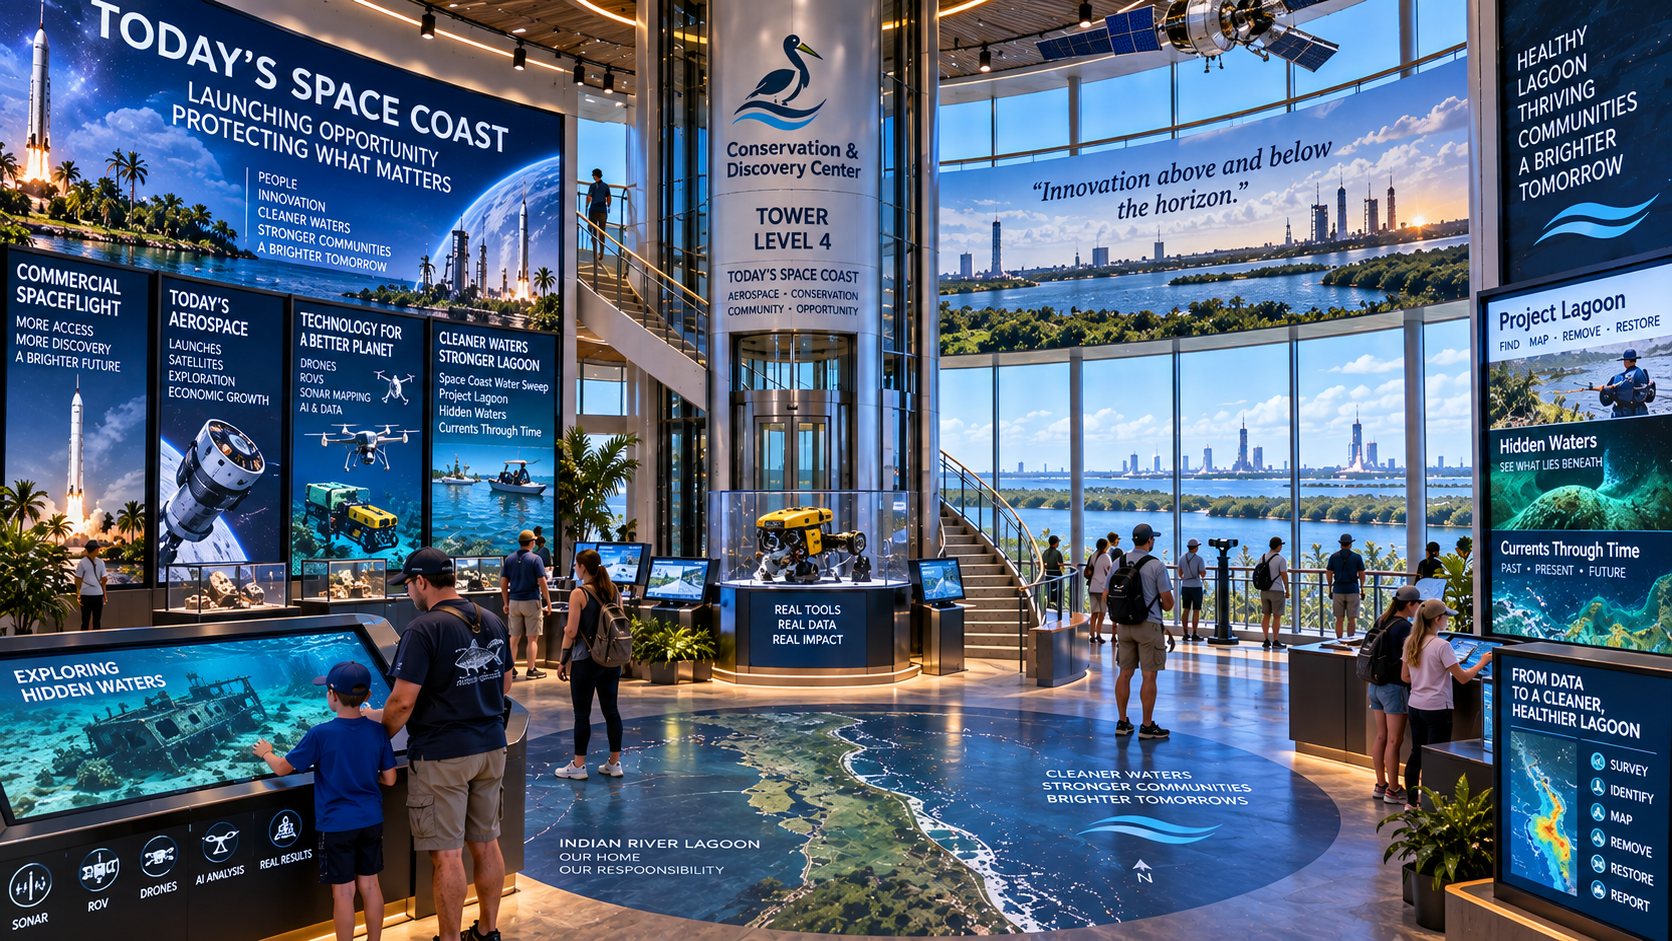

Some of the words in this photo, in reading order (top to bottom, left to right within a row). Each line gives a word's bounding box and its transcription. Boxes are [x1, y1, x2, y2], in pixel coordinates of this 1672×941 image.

[1518, 25, 1587, 71] HEALTHY
[1518, 53, 1586, 97] LAGOON
[291, 68, 399, 127] SPACE
[411, 105, 509, 152] COAST
[1517, 79, 1595, 122] THRIVING
[187, 81, 312, 136] LAUNCHING
[320, 121, 438, 169] OPPORTUNITY
[1517, 90, 1637, 148] COMMUNITIES
[173, 104, 308, 158] PROTECTING
[315, 143, 371, 174] WHAT
[377, 159, 451, 193] MATTERS
[727, 139, 841, 157] Conservation
[846, 142, 858, 159] &
[1519, 157, 1530, 176] A
[1535, 128, 1616, 170] BRIGHTER
[727, 161, 806, 179] Discovery
[811, 160, 861, 179] Center
[1157, 162, 1216, 185] above
[1222, 147, 1263, 175] and
[1270, 140, 1332, 167] below
[259, 171, 297, 190] PEOPLE
[1519, 154, 1623, 201] TOMORROW
[259, 189, 325, 212] INNOVATION
[1118, 198, 1149, 220] the
[258, 206, 307, 226] CLEANER
[310, 216, 351, 234] WATERS
[756, 207, 828, 225] TOWER
[258, 224, 316, 245] STRONGER
[319, 235, 391, 257] COMMUNITIES
[755, 232, 813, 250] LEVEL
[819, 233, 831, 250] 4
[257, 241, 266, 253] A
[269, 243, 322, 263] BRIGHTER
[325, 252, 387, 272] TOMORROW
[17, 263, 121, 295] COMMERCIAL
[780, 268, 817, 281] SPACE
[820, 269, 859, 283] COAST
[17, 286, 121, 316] SPACEFLIGHT
[728, 289, 779, 301] AEROSPACE
[791, 289, 858, 301] CONSERVATION
[728, 304, 784, 316] COMMUNITY
[796, 304, 859, 316] OPPORTUNITY
[1500, 304, 1557, 332] Project
[1562, 294, 1625, 321] Lagoon
[16, 315, 49, 331] MORE
[52, 321, 94, 337] ACCESS
[169, 311, 248, 336] AEROSPACE
[300, 312, 378, 336] TECHNOLOGY
[381, 324, 402, 340] FOR
[1500, 339, 1520, 351] FIND
[1529, 334, 1549, 347] MAP
[1563, 325, 1601, 342] REMOVE
[1616, 315, 1660, 333] RESTORE
[16, 333, 49, 348] MORE
[52, 337, 111, 355] DISCOVERY
[169, 338, 222, 355] LAUNCHES
[300, 332, 308, 346] A
[310, 333, 349, 352] BETTER
[353, 339, 394, 357] PLANET
[439, 331, 486, 349] CLEANER
[489, 337, 528, 353] WATERS
[15, 350, 24, 363] A
[27, 352, 79, 368] BRIGHTER
[82, 358, 121, 372] FUTURE
[169, 354, 223, 371] SATELLITES
[300, 358, 336, 372] DRONES
[439, 349, 495, 367] STRONGER
[498, 356, 540, 371] LAGOON
[169, 370, 235, 387] EXPLORATION
[300, 372, 324, 384] ROVS
[439, 372, 466, 386] Space
[468, 375, 492, 387] Coast
[494, 377, 520, 389] Water
[522, 379, 549, 394] Sweep
[169, 386, 224, 401] ECONOMIC
[226, 391, 269, 406] GROWTH
[300, 387, 330, 399] SONAR
[333, 390, 371, 402] MAPPING
[439, 388, 471, 403] Project
[474, 391, 508, 406] Lagoon
[299, 402, 309, 412] AI
[311, 403, 318, 413] &
[321, 404, 343, 415] DATA
[439, 405, 472, 418] Hidden
[474, 407, 507, 420] Waters
[439, 421, 479, 434] Currents
[480, 423, 518, 439] Through
[520, 426, 542, 437] Time
[1500, 437, 1545, 454] Hidden
[1549, 434, 1597, 451] Waters
[1500, 461, 1514, 472] SEE
[1516, 460, 1540, 471] WHAT
[1542, 459, 1560, 470] LIES
[1562, 457, 1603, 469] BENEATH
[1501, 540, 1550, 556] Currents
[1552, 541, 1603, 561] Through
[1606, 542, 1640, 558] Time
[1501, 563, 1522, 574] PAST
[1535, 564, 1574, 576] PRESENT
[1589, 566, 1626, 578] FUTURE
[775, 604, 802, 615] REAL
[805, 605, 841, 615] TOOLS
[778, 619, 805, 630] REAL
[809, 619, 837, 630] DATA
[773, 634, 800, 645] REAL
[803, 634, 843, 645] IMPACT
[14, 661, 119, 684] EXPLORING
[1513, 668, 1547, 686] FROM
[1551, 673, 1584, 691] DATA
[21, 682, 94, 702] HIDDEN
[96, 674, 166, 693] WATERS
[1512, 685, 1528, 700] TO
[1531, 688, 1540, 702] A
[1543, 690, 1605, 715] CLEANER,
[1513, 703, 1576, 727] HEALTHIER
[1581, 714, 1640, 739] LAGOON
[1046, 770, 1121, 779] CLEANER
[1125, 771, 1192, 779] WATERS
[1610, 759, 1648, 777] SURVEY
[1042, 782, 1131, 791] STRONGER
[1136, 783, 1252, 792] COMMUNITIES
[1610, 785, 1654, 804] IDENTIFY
[1047, 795, 1131, 804] BRIGHTER
[1135, 795, 1248, 805] TOMORROWS
[1611, 810, 1633, 825] MAP
[560, 839, 621, 848] INDIAN
[628, 839, 678, 848] RIVER
[685, 839, 760, 849] LAGOON
[1611, 836, 1652, 858] REMOVE
[260, 857, 280, 869] REAL
[281, 849, 312, 865] RESULTS
[559, 853, 591, 861] OUR
[597, 853, 640, 862] HOME
[196, 874, 204, 885] AI
[206, 865, 245, 883] ANALYSIS
[559, 865, 591, 874] OUR
[1137, 873, 1153, 883] N
[1611, 862, 1654, 886] RESTORE
[140, 881, 177, 899] DRONES
[88, 898, 109, 912] ROV
[1611, 889, 1650, 912] REPORT
[12, 912, 48, 930] SONAR
